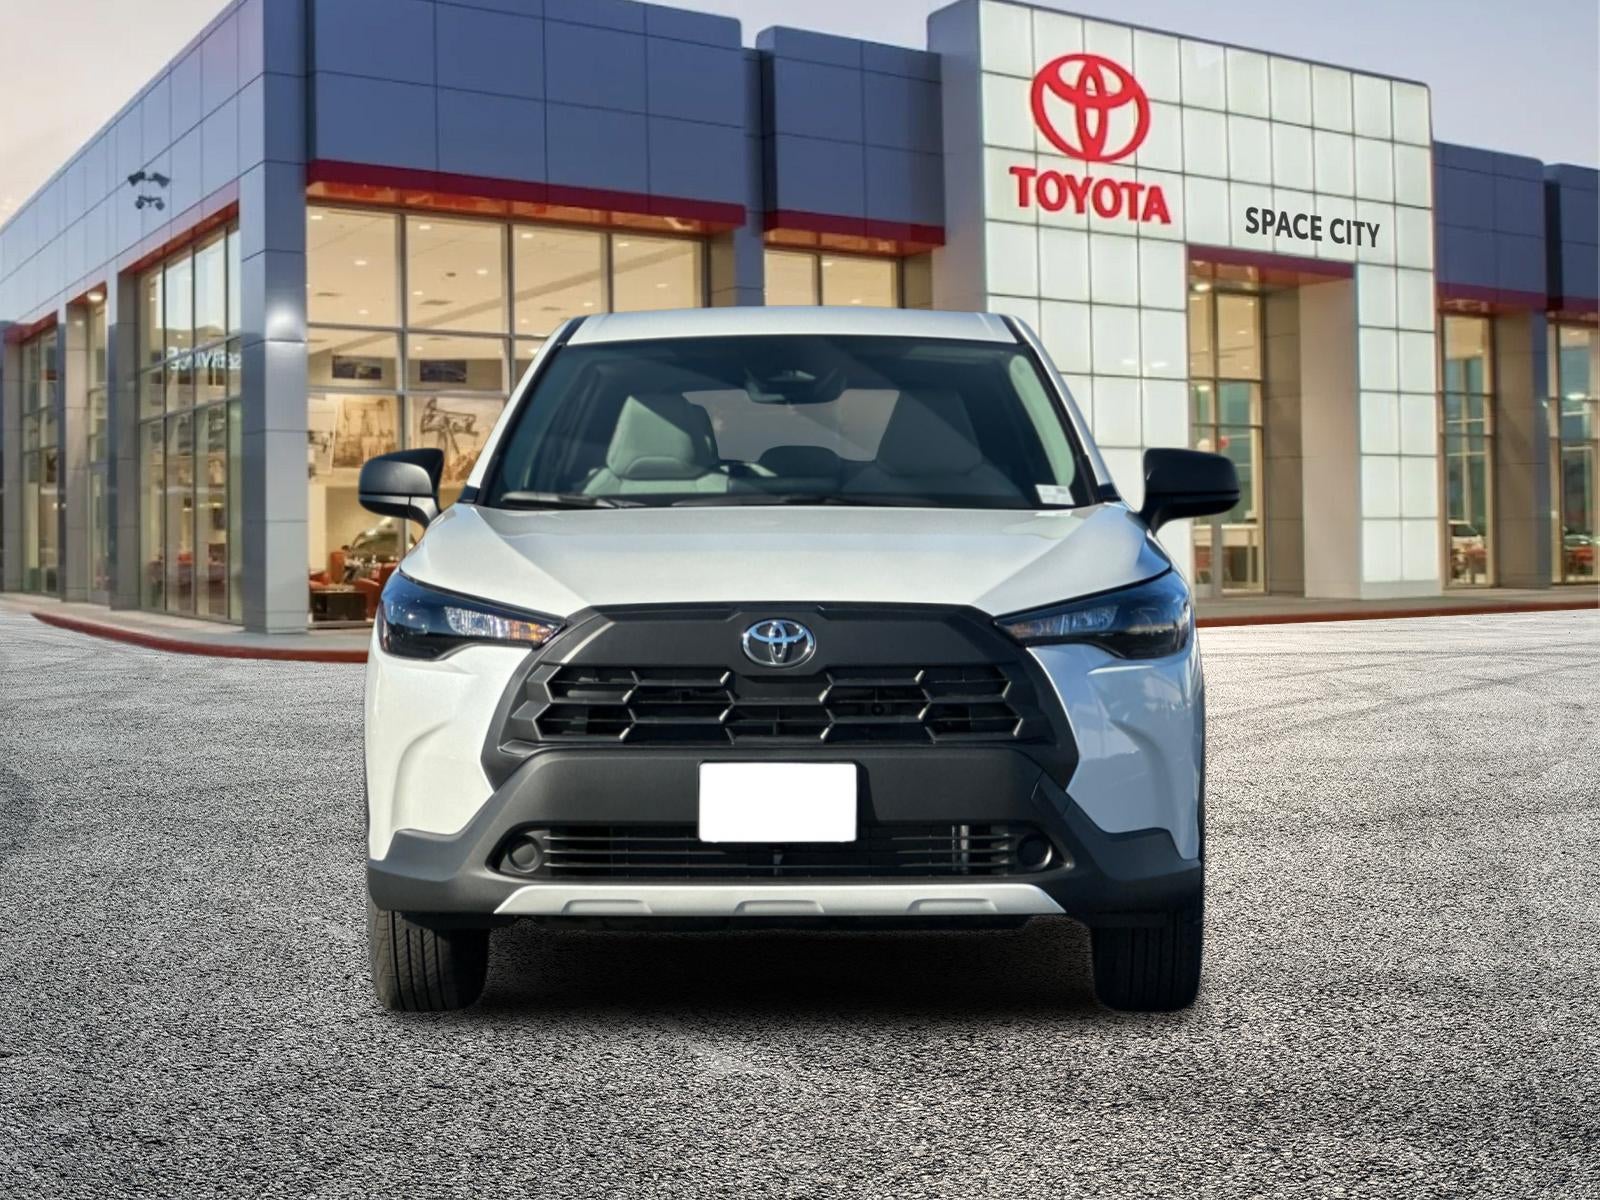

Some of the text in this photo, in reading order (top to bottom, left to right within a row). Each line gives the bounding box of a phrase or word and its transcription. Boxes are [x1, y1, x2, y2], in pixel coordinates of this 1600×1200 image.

[1009, 166, 1171, 225] TOYOTA
[1245, 206, 1381, 248] SPACE CITY
